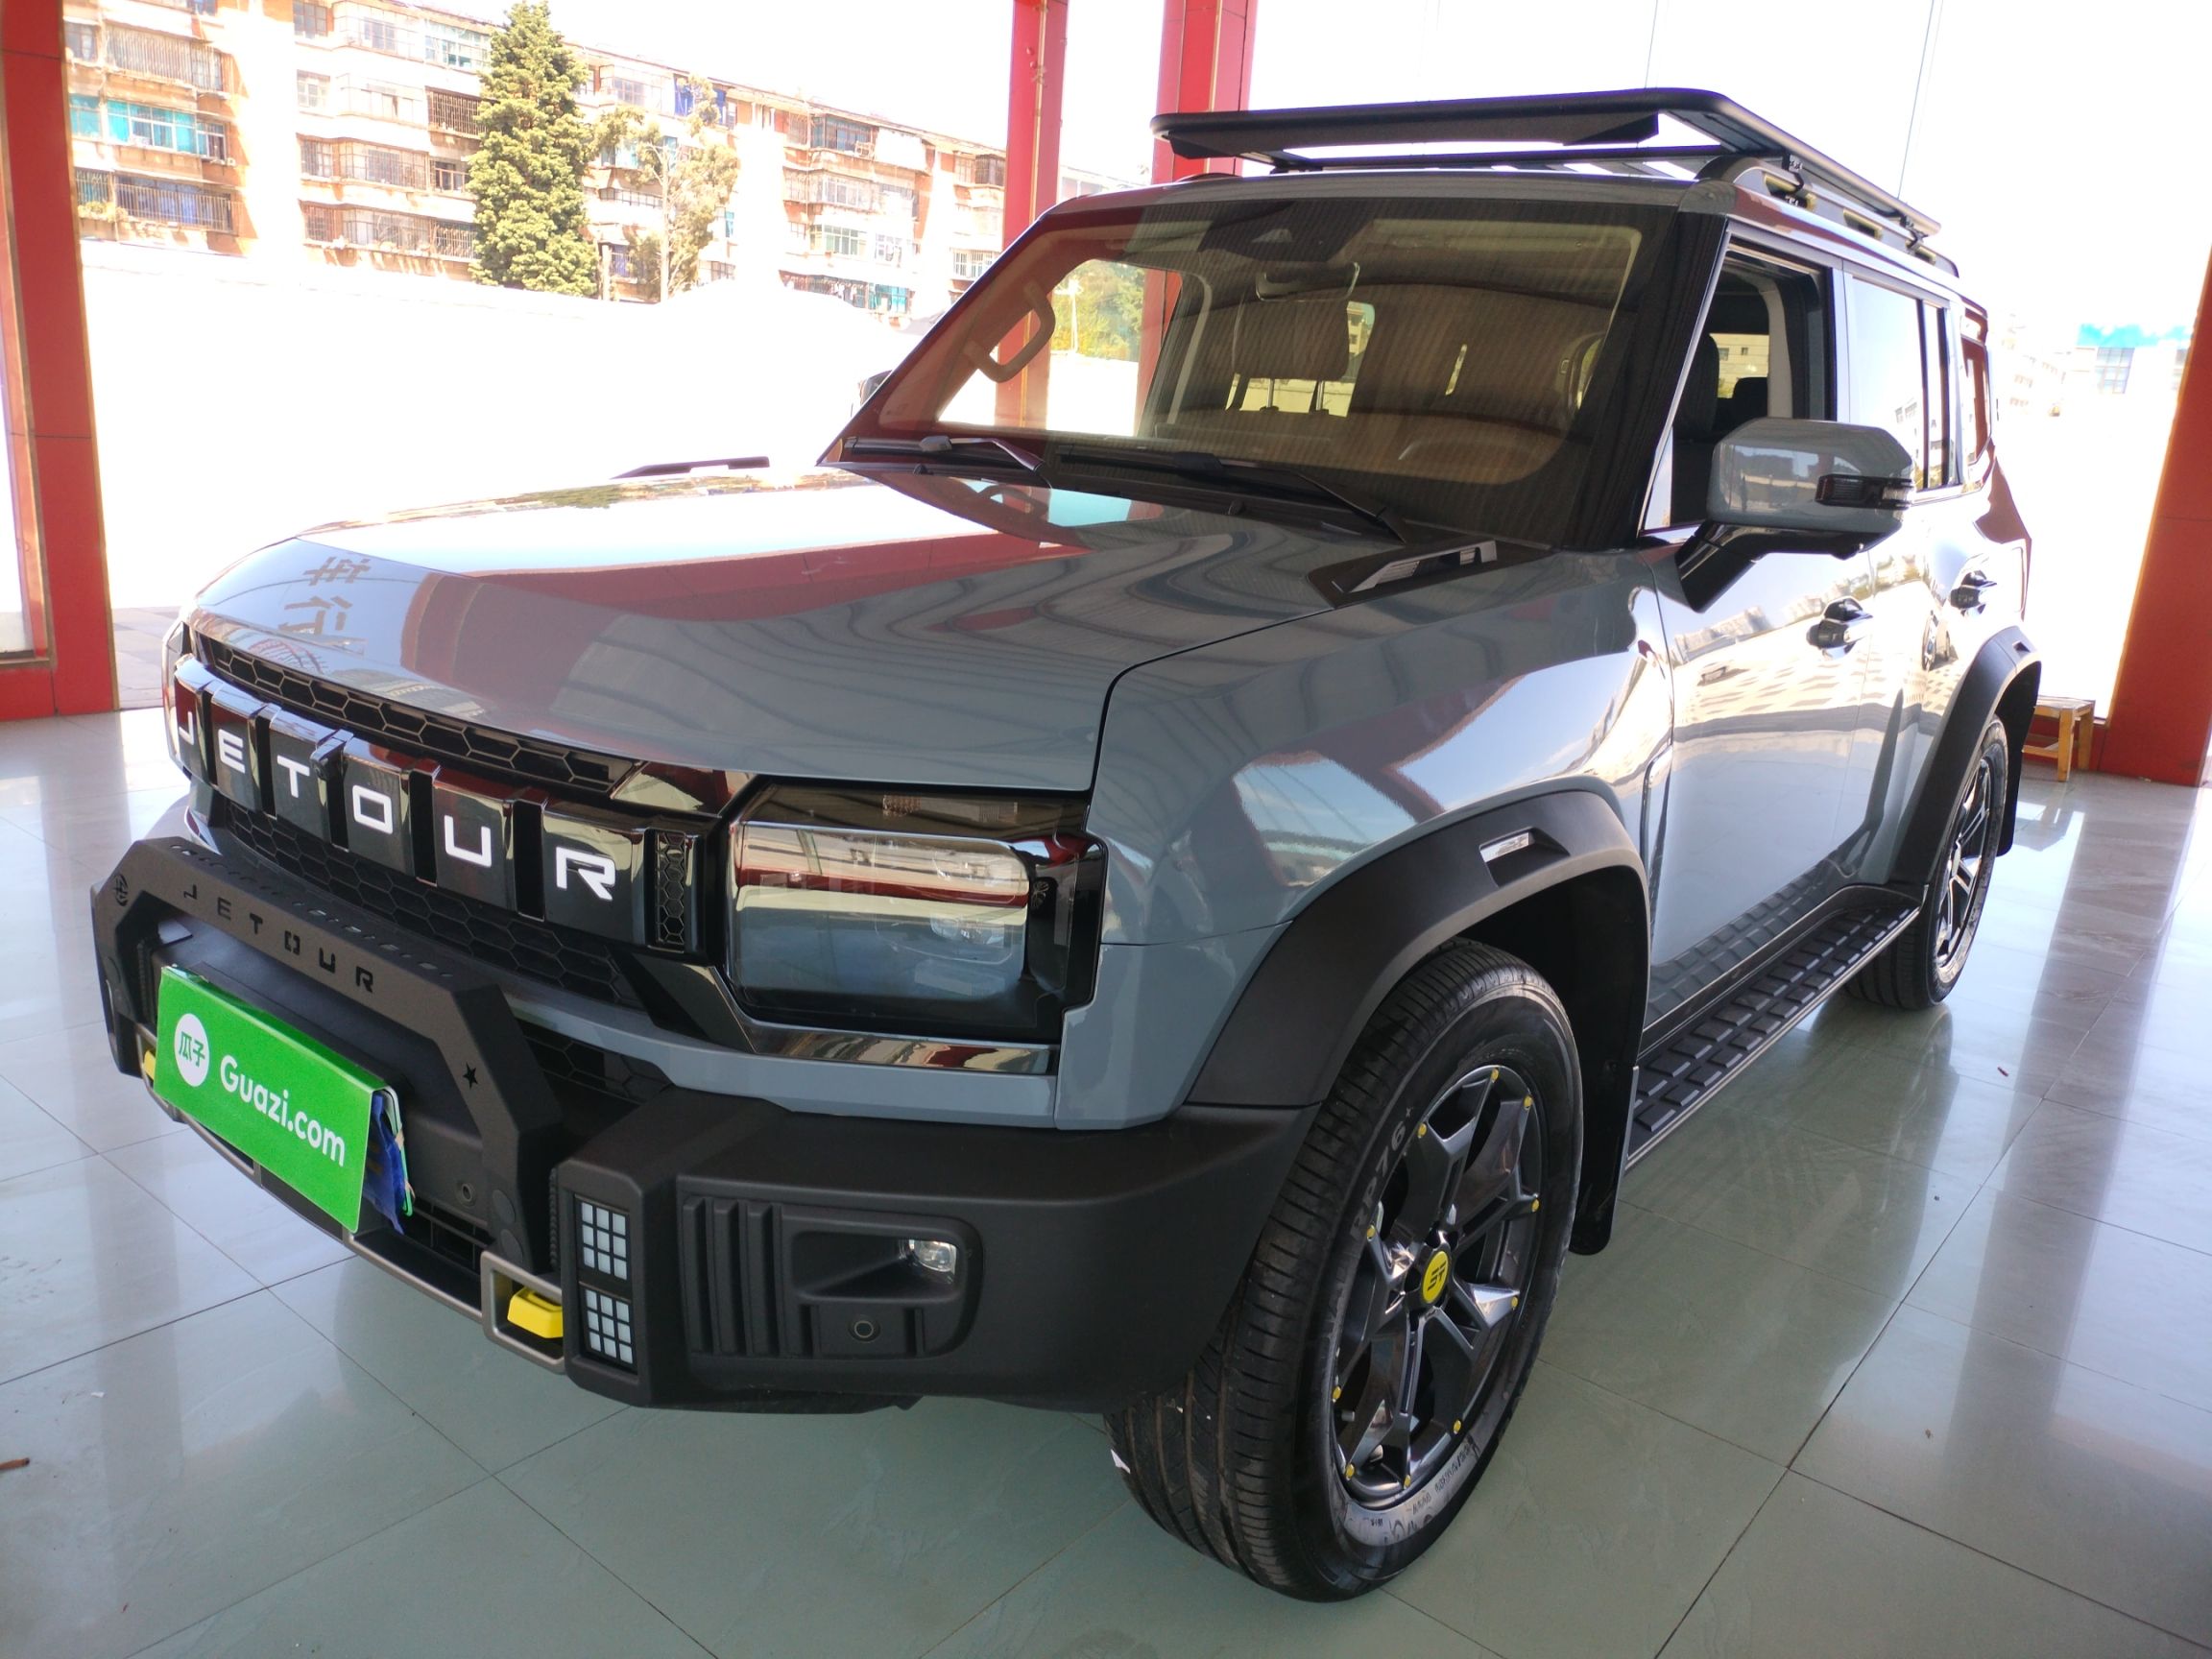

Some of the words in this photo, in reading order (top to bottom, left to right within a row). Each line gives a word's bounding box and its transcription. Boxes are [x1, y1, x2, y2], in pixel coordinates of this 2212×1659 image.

[179, 711, 615, 901] JETOUR
[183, 883, 373, 993] JETOUR
[179, 1031, 205, 1068] 瓜子
[220, 1055, 346, 1166] Guazi.com
